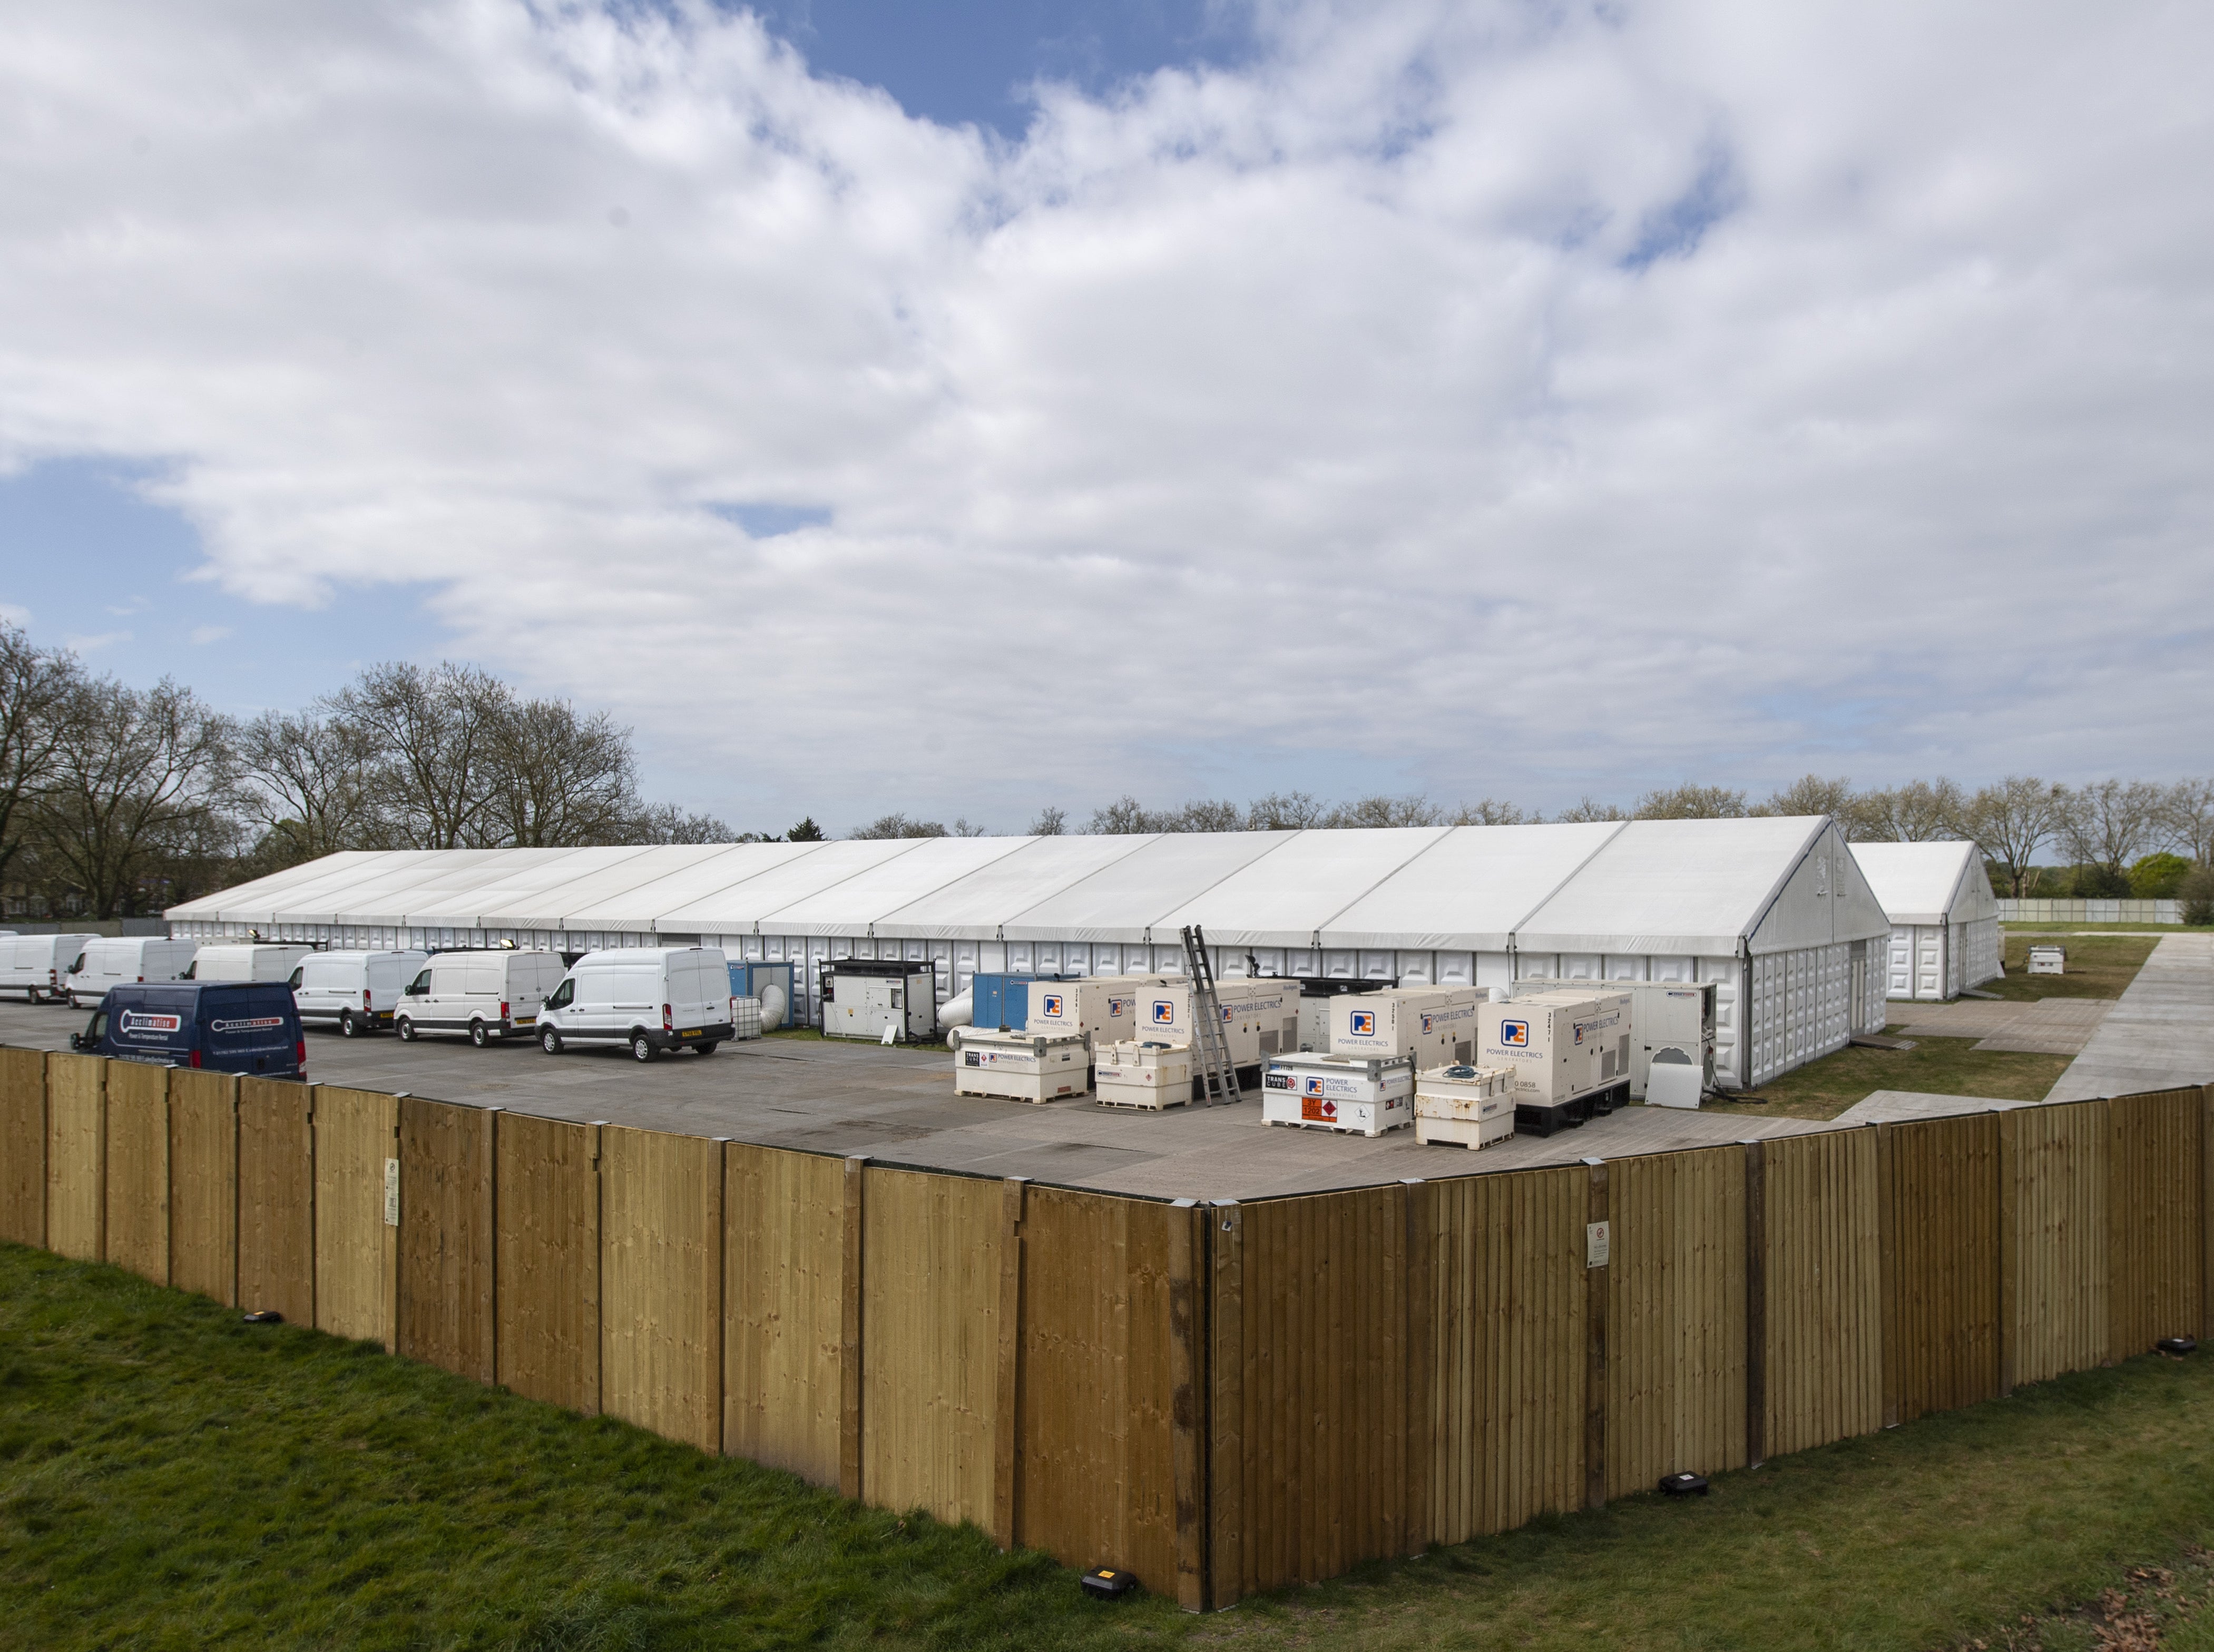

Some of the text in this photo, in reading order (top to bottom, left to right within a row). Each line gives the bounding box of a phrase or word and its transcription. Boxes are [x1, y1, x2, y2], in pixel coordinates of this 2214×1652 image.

[1046, 999, 1060, 1014] PE
[1112, 1002, 1121, 1014] PE
[1156, 1005, 1170, 1020] PE
[1223, 1007, 1231, 1020] PE
[1233, 1000, 1281, 1013] POWER ELECTRICS
[131, 1017, 170, 1027] Acclimatise
[1433, 1008, 1474, 1023] POWER ELECTRICS
[1354, 1015, 1371, 1032] PE
[1583, 1016, 1618, 1032] POWER ELECTRICS
[1505, 1025, 1525, 1043] PE
[1486, 1048, 1543, 1059] POWER ELECTRICS
[1309, 1080, 1321, 1093] PE
